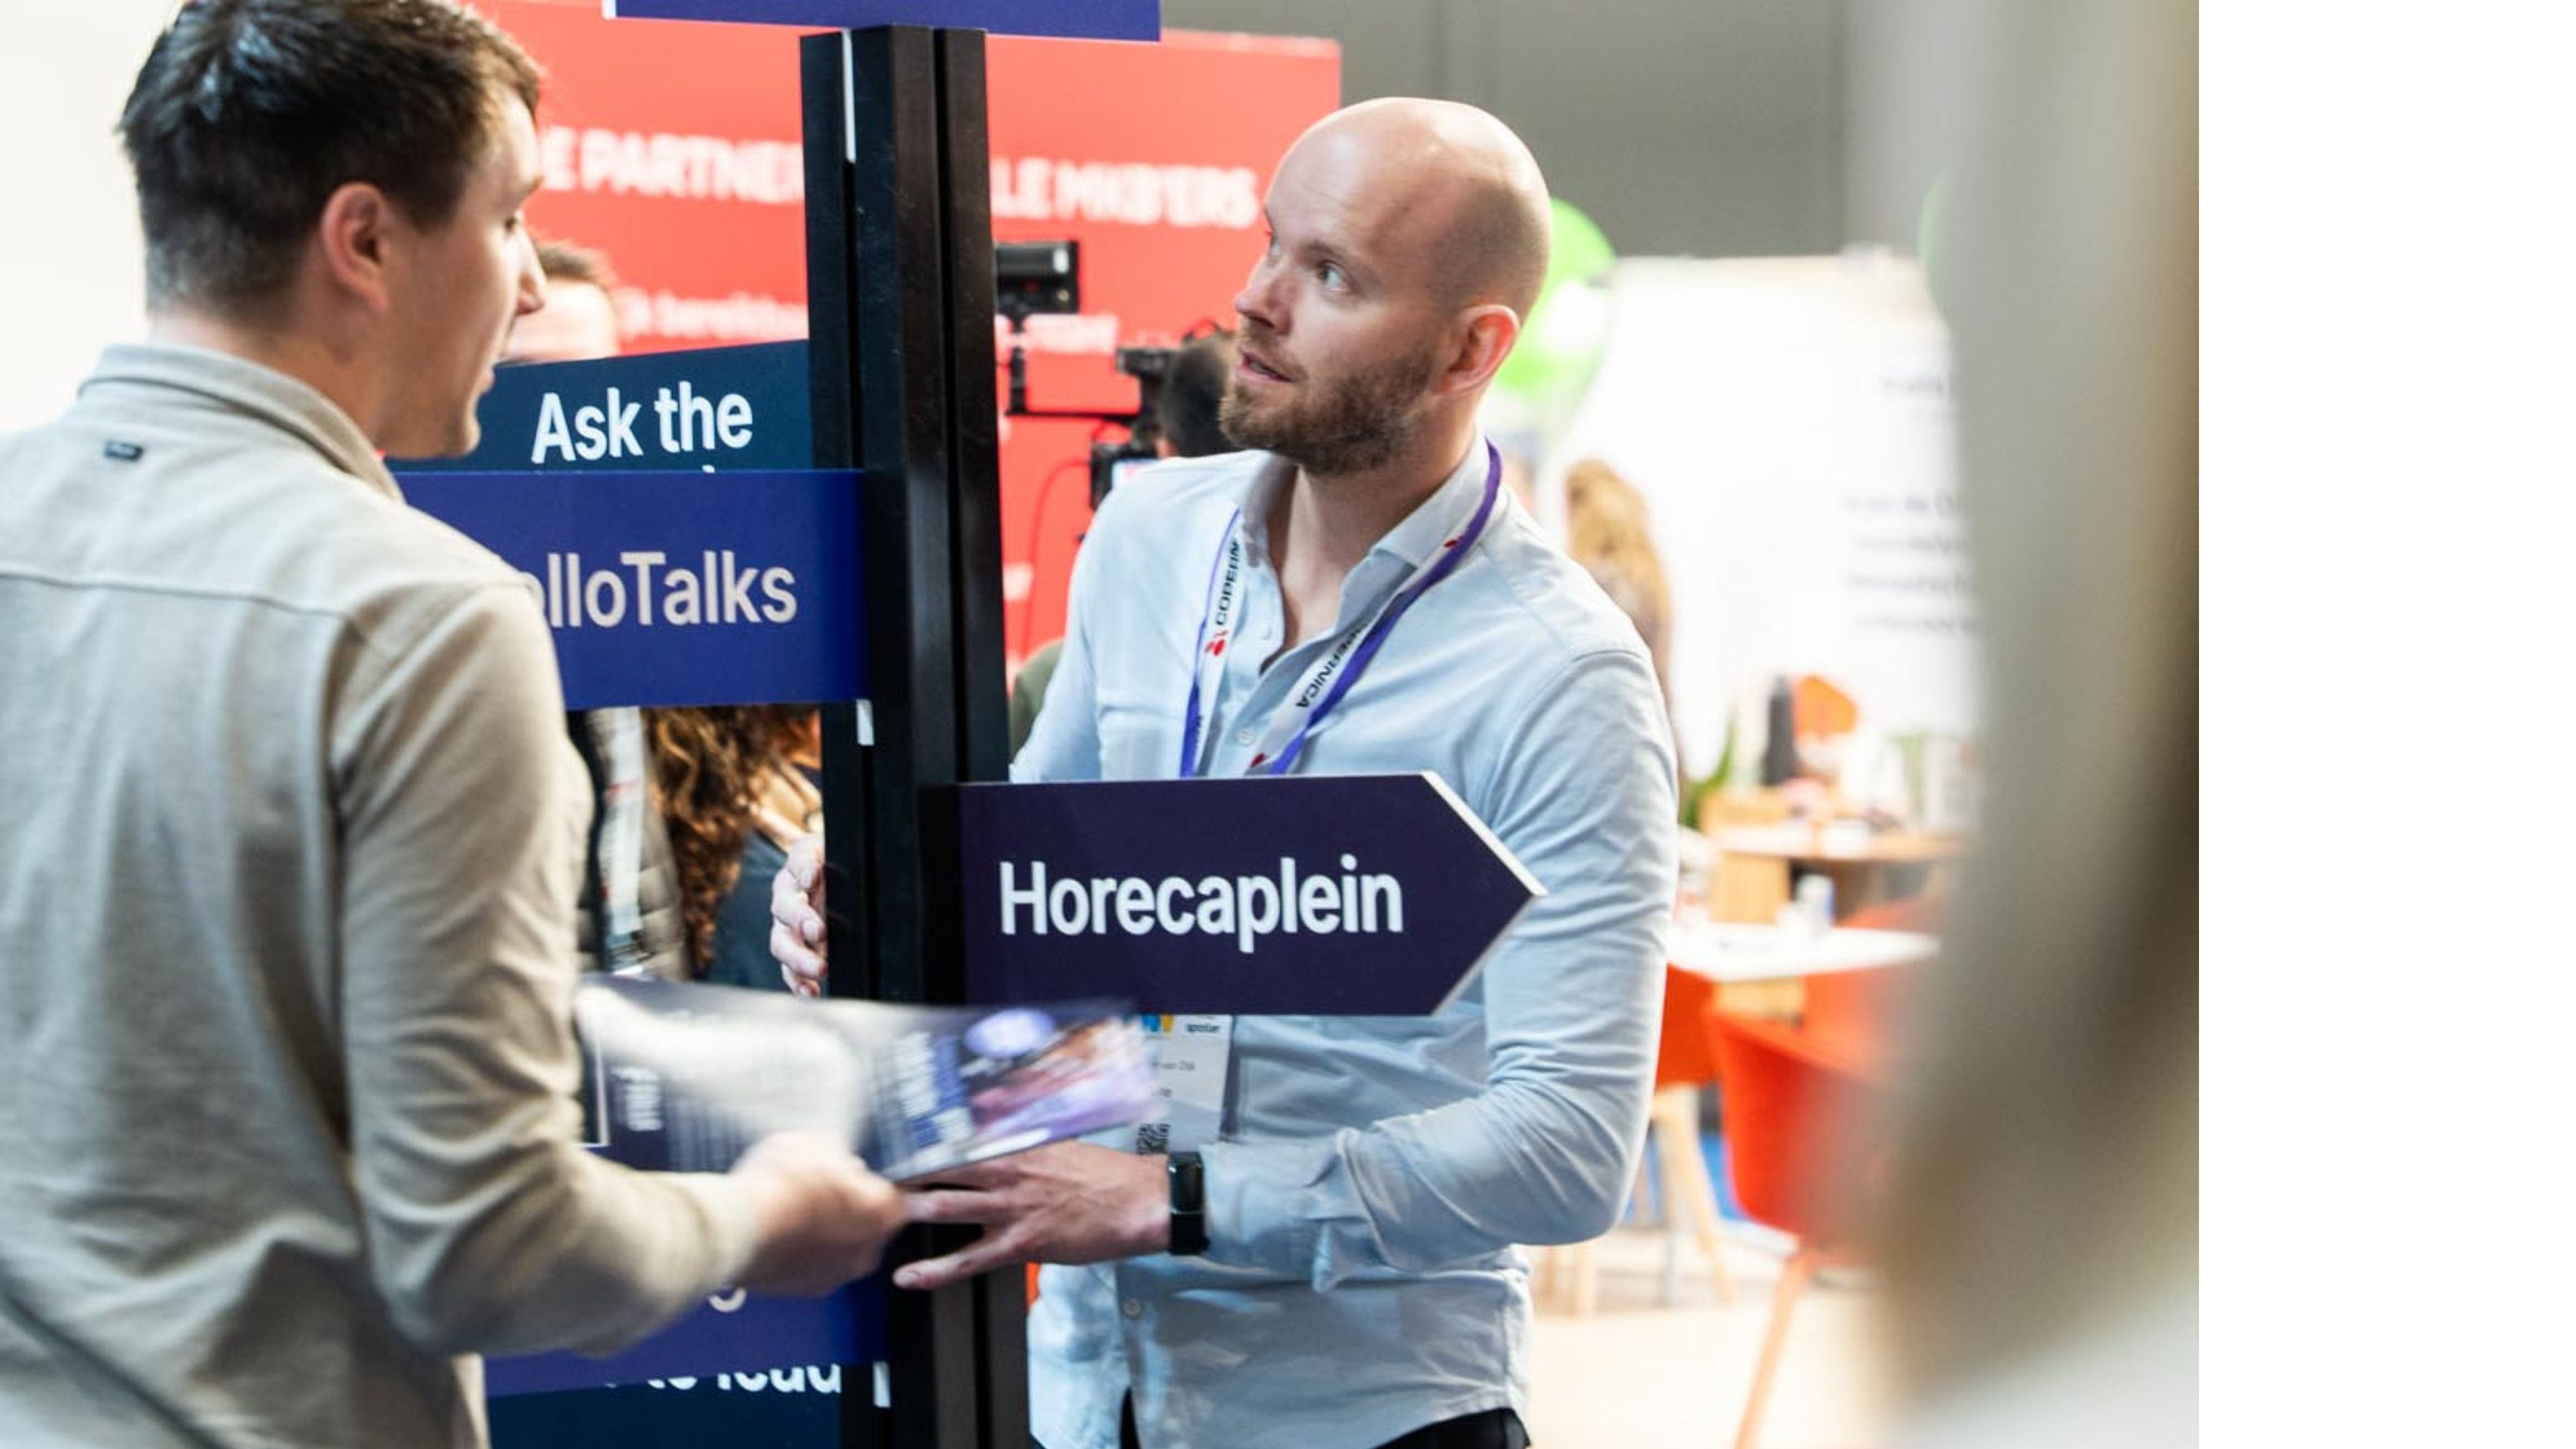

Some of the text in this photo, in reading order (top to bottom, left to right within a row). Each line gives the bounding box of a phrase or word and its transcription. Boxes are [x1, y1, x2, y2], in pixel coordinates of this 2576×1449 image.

[538, 124, 578, 192] E
[990, 156, 1052, 220] LE
[531, 380, 753, 464] Ask the
[521, 550, 798, 628] lloTalks
[1000, 853, 1403, 954] Horecaplein
